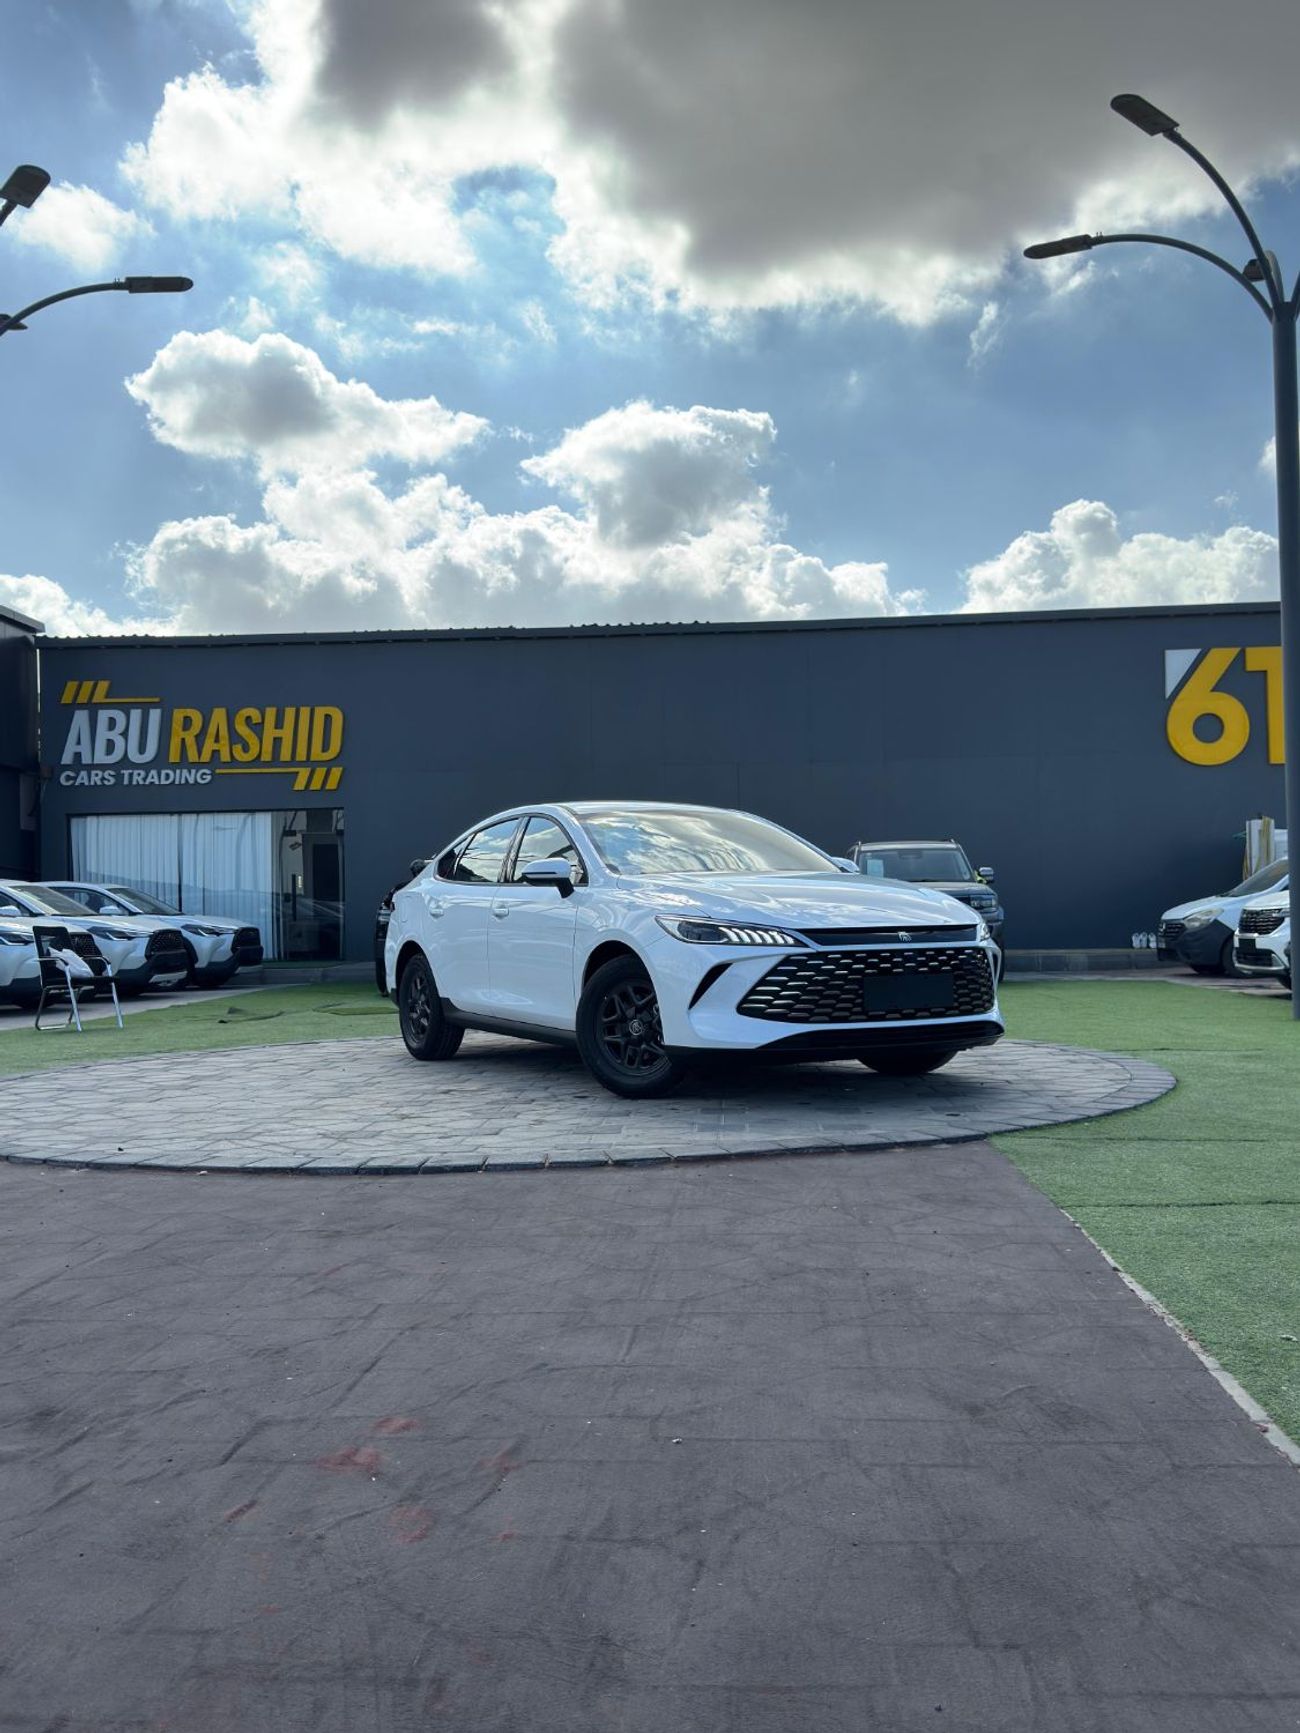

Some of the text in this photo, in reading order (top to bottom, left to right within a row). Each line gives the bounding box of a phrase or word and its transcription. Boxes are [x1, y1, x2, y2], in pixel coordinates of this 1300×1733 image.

[60, 706, 344, 765] ABU RASHID
[1166, 647, 1286, 766] 61
[59, 768, 213, 786] CARS TRADING
